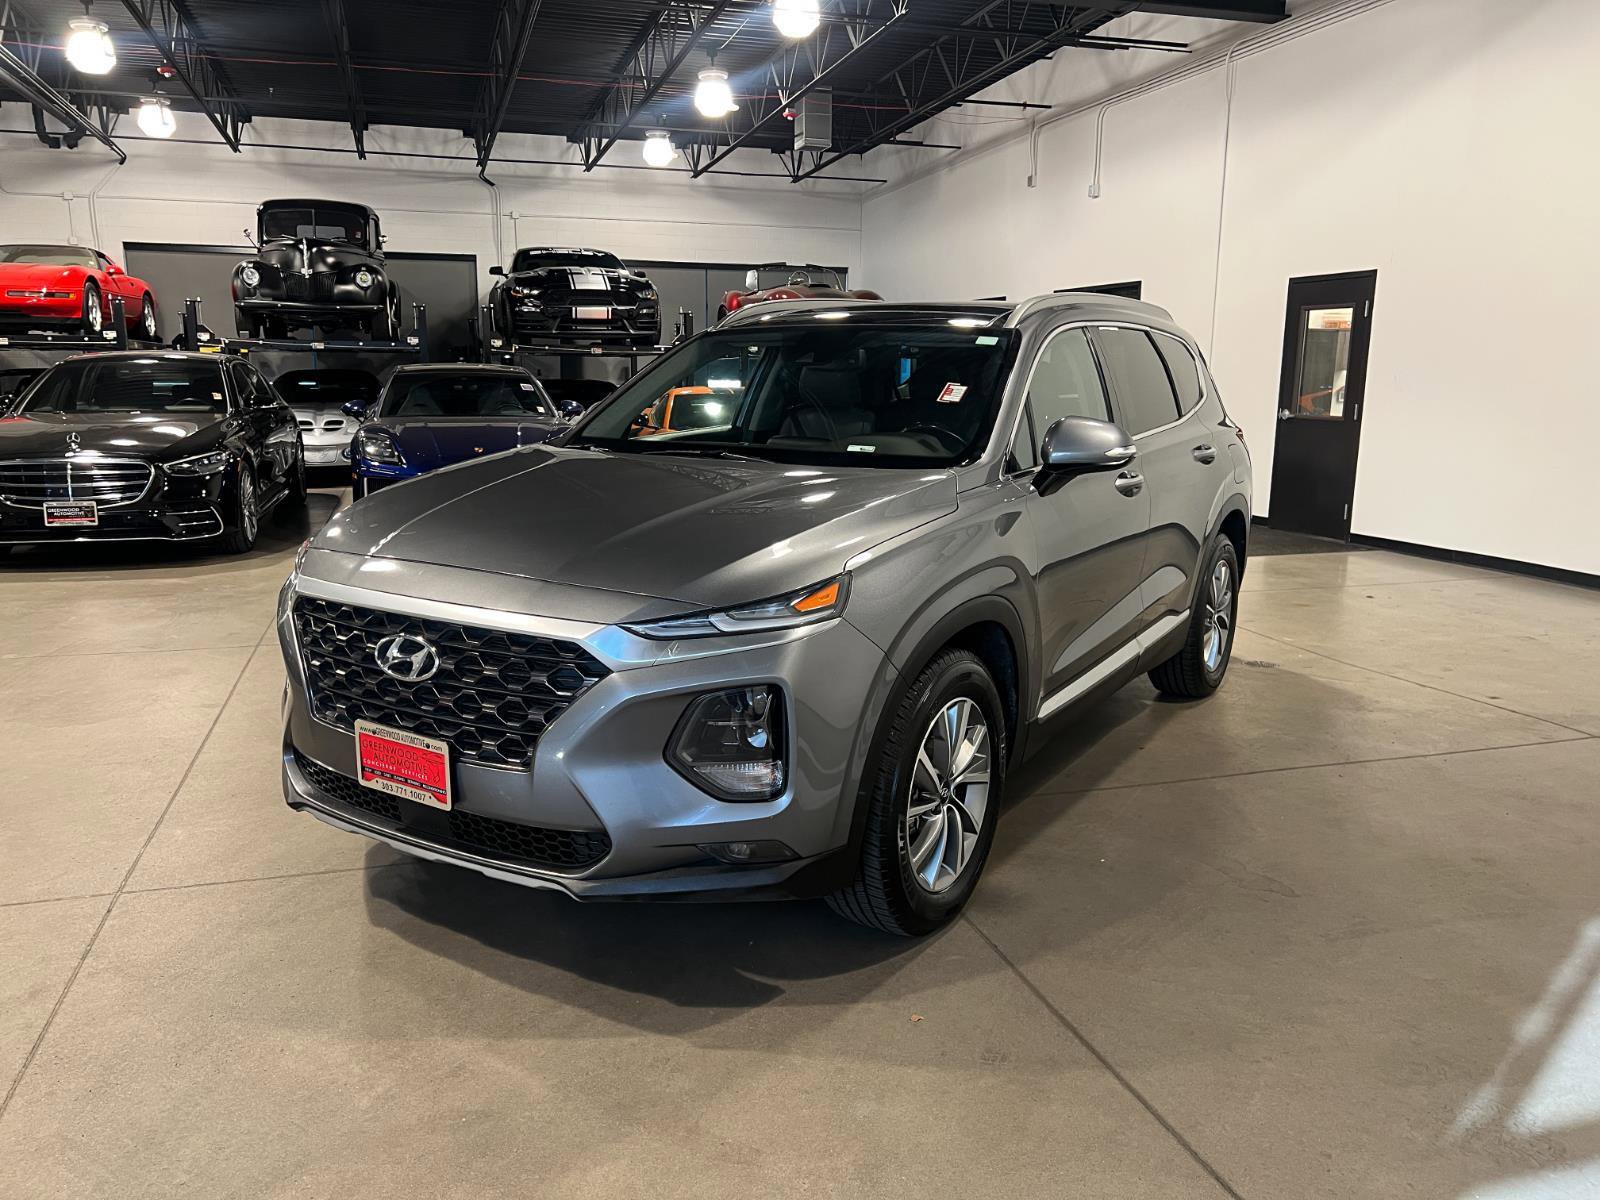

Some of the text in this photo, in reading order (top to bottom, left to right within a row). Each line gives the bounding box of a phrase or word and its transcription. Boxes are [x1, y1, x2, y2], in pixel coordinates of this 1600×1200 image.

[361, 739, 419, 761] GREENWOOD
[373, 752, 428, 774] AUTOMOTIVE
[401, 767, 428, 780] SERVICES
[381, 781, 427, 802] 303.771.1007
